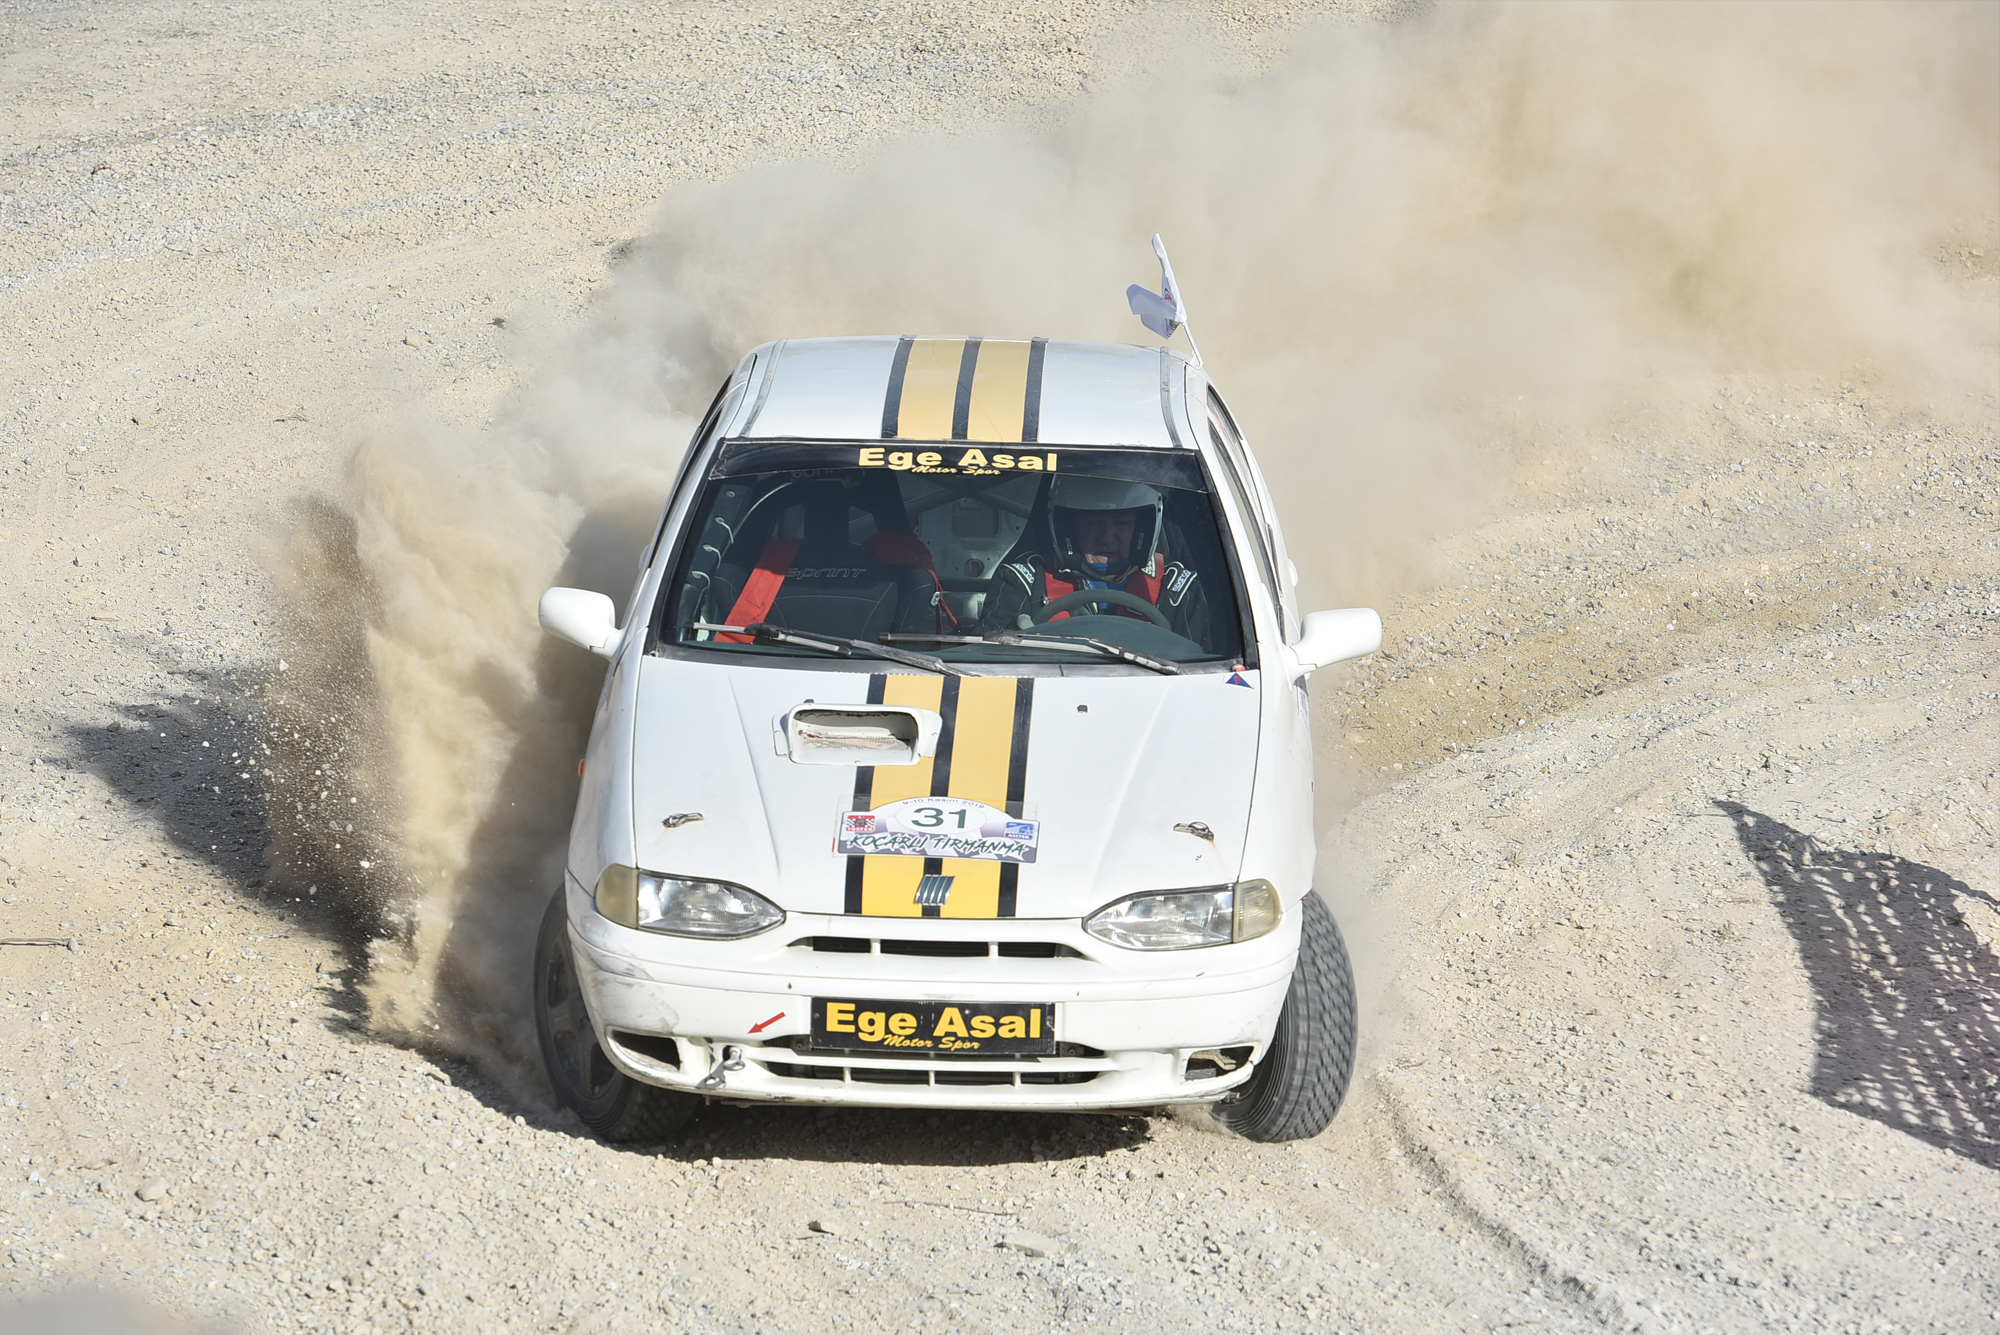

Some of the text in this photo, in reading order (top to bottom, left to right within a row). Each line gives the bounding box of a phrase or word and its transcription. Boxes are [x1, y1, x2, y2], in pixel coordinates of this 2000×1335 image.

[859, 447, 1058, 471] Ege Asal
[911, 464, 1002, 476] Motor Spor
[911, 807, 967, 829] 31
[849, 834, 1026, 856] KOÇARLI TIRMANMA
[826, 1001, 1042, 1042] Ege Asal
[882, 1034, 981, 1051] Motor Spor
